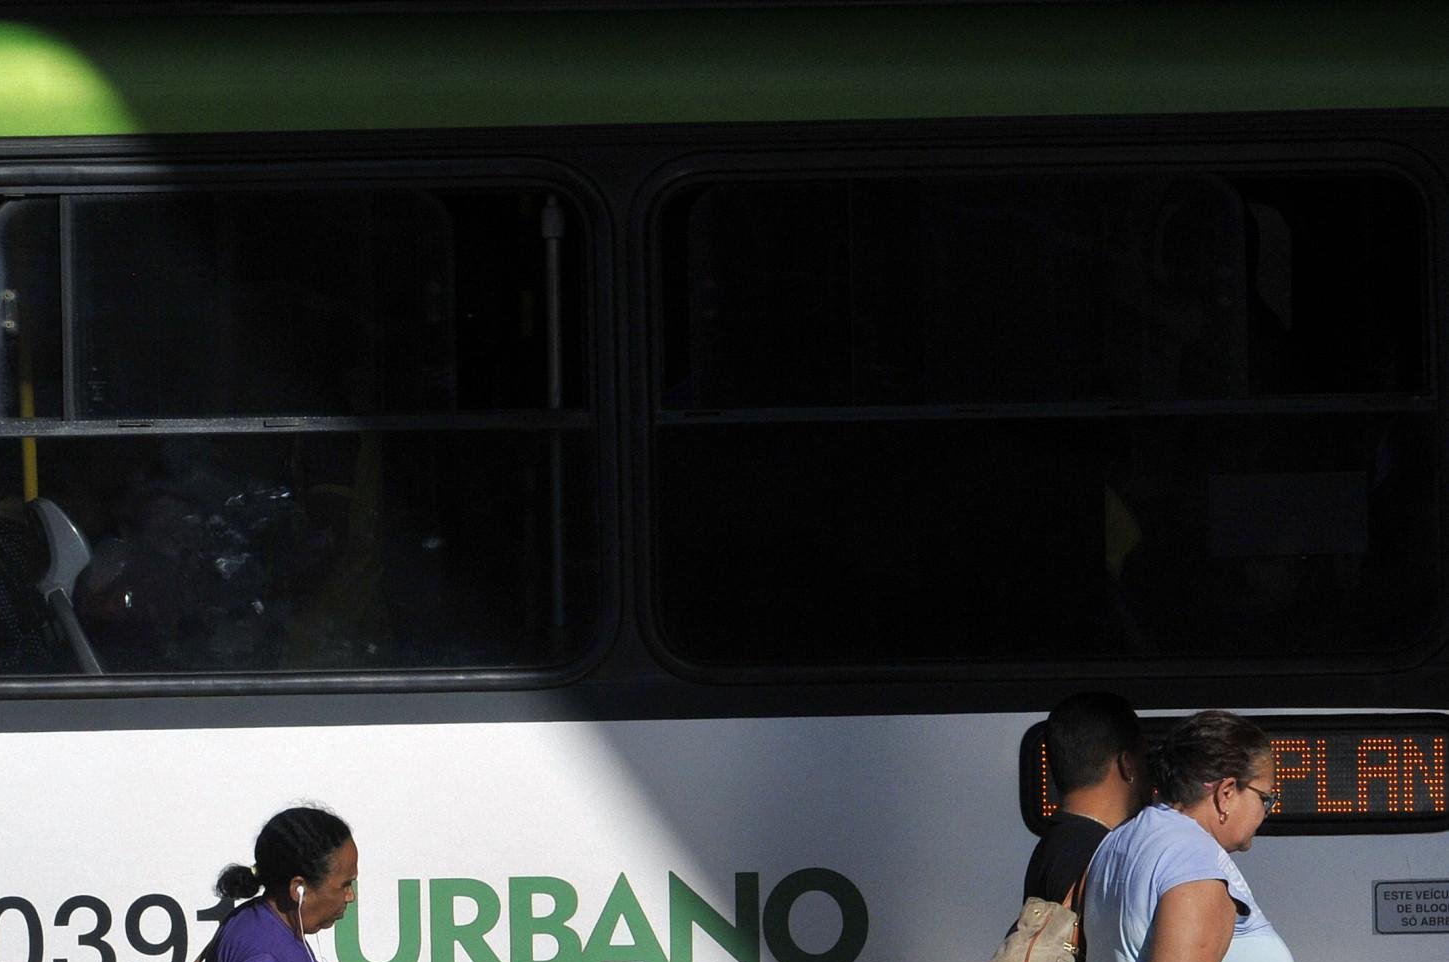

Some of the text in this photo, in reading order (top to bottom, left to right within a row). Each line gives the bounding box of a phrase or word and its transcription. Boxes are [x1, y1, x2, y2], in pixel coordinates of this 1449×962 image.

[1270, 737, 1445, 813] PLAN
[1383, 890, 1413, 901] ESTE
[1397, 902, 1449, 913] DE BLOQ
[1401, 914, 1418, 927] SÓ
